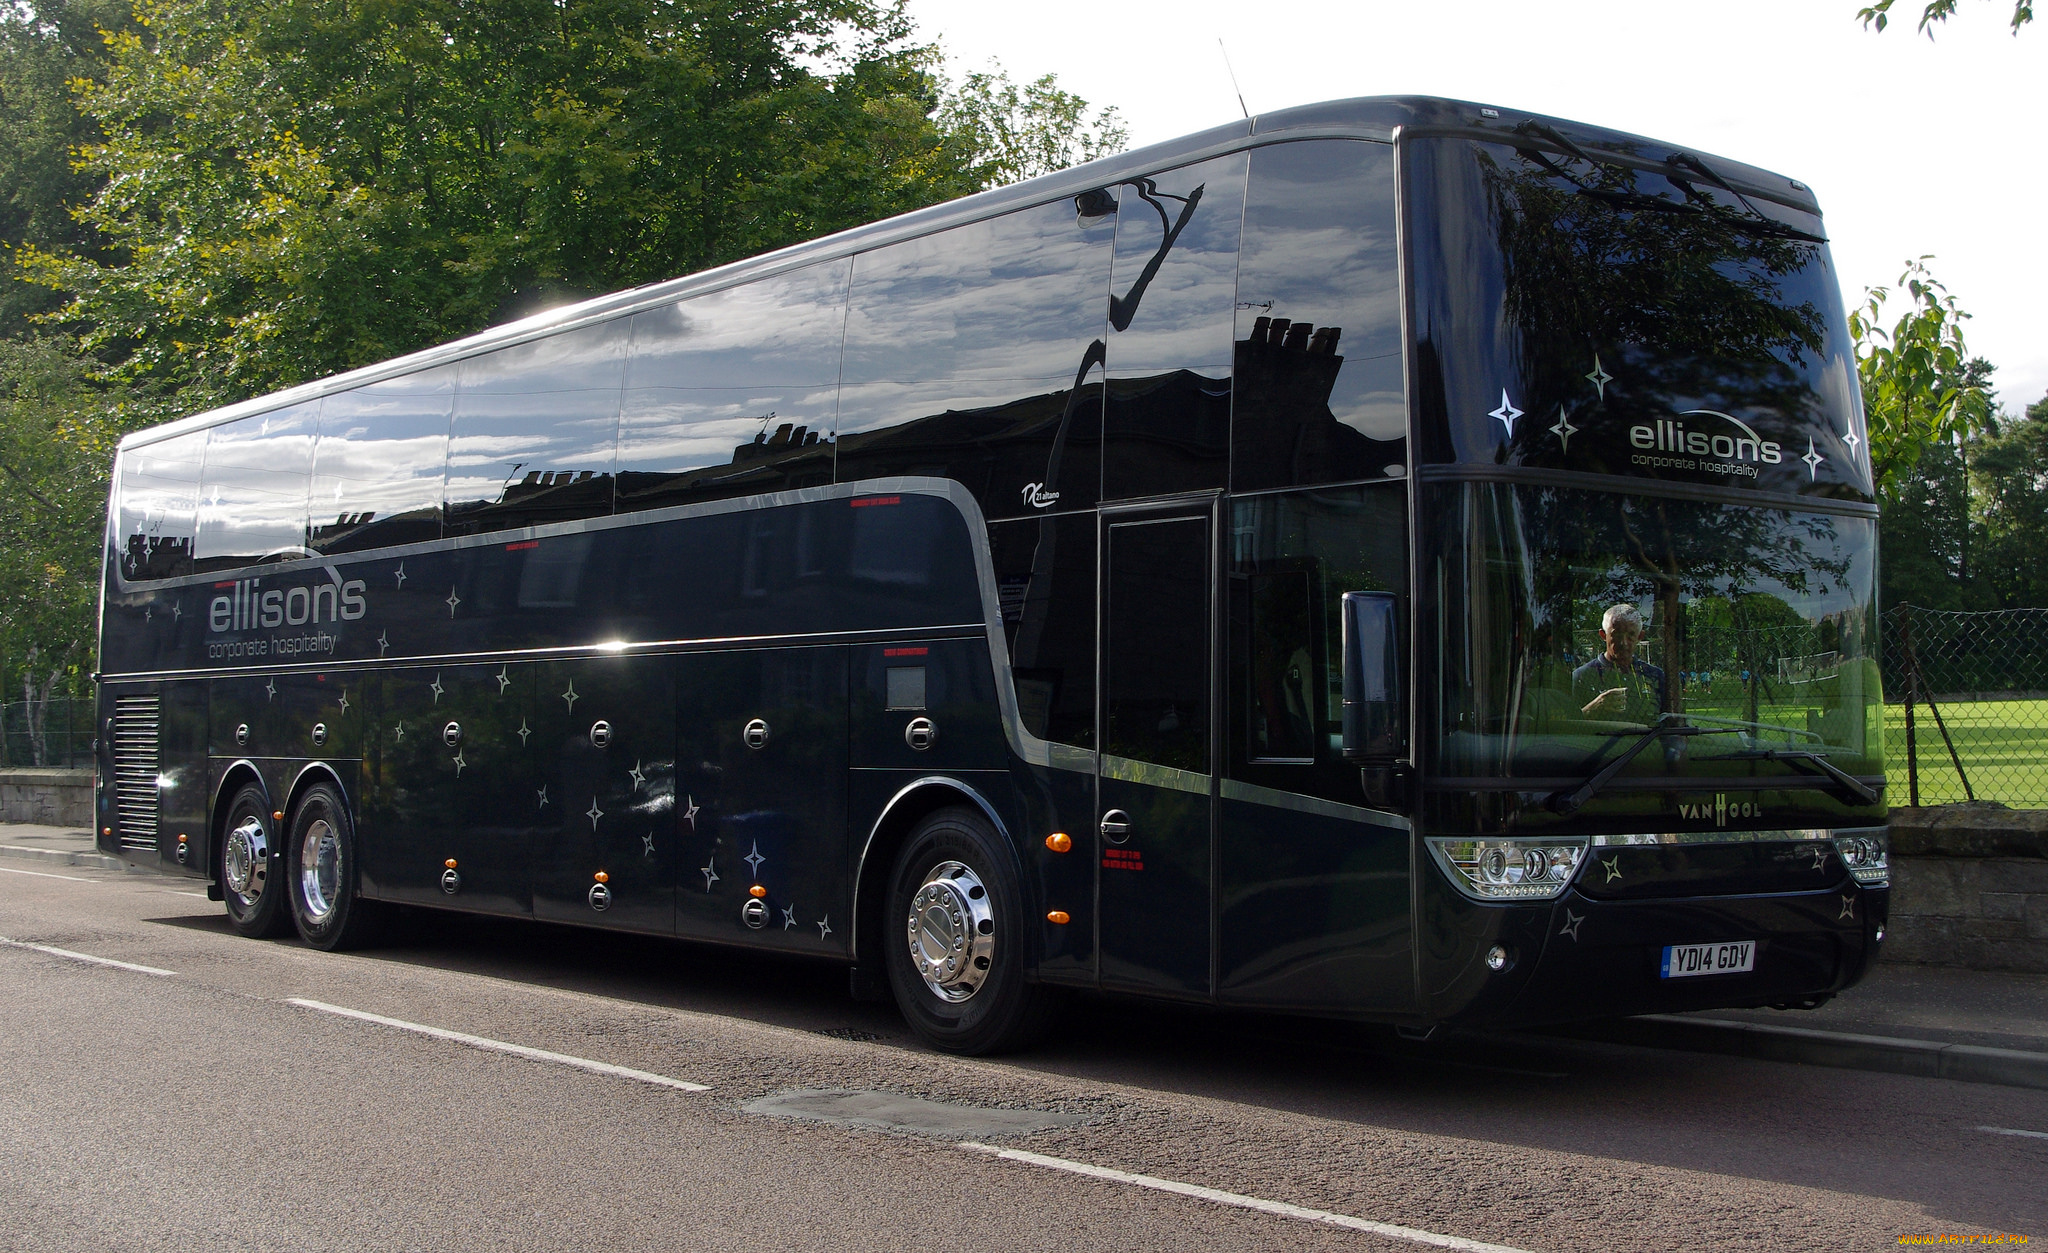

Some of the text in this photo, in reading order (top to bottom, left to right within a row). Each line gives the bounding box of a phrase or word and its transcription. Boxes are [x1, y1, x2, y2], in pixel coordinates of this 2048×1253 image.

[1629, 419, 1782, 464] ellisons
[1631, 453, 1759, 479] corporate hospitality
[209, 578, 367, 633] ellisons
[209, 630, 337, 662] corporate hospitality
[1718, 944, 1749, 969] GDV
